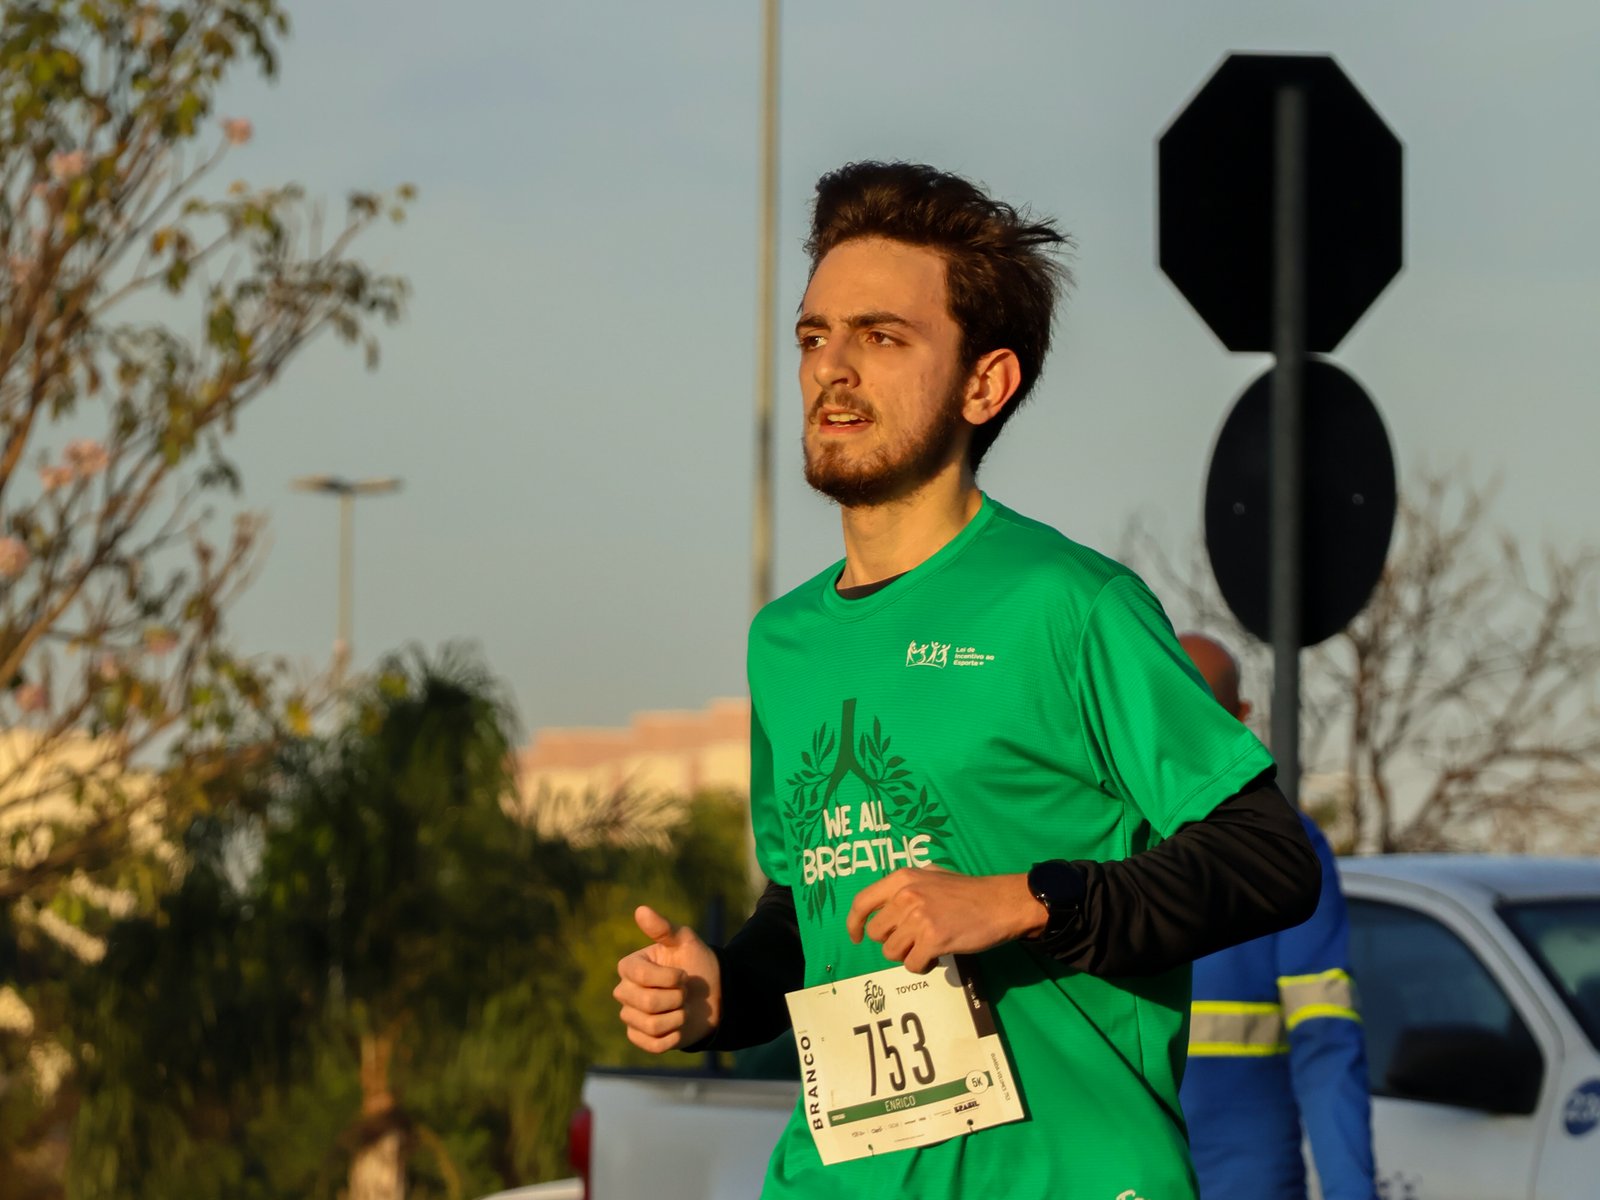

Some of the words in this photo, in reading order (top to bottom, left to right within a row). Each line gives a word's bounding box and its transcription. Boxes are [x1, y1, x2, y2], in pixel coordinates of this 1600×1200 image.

[823, 805, 853, 840] WE
[859, 800, 891, 833] ALL
[803, 834, 932, 885] BREATHE
[895, 981, 929, 995] TOYOTA
[853, 1012, 936, 1097] 753
[800, 1036, 824, 1130] BRANCO
[971, 1077, 983, 1087] 5K
[884, 1095, 916, 1112] ENRICO
